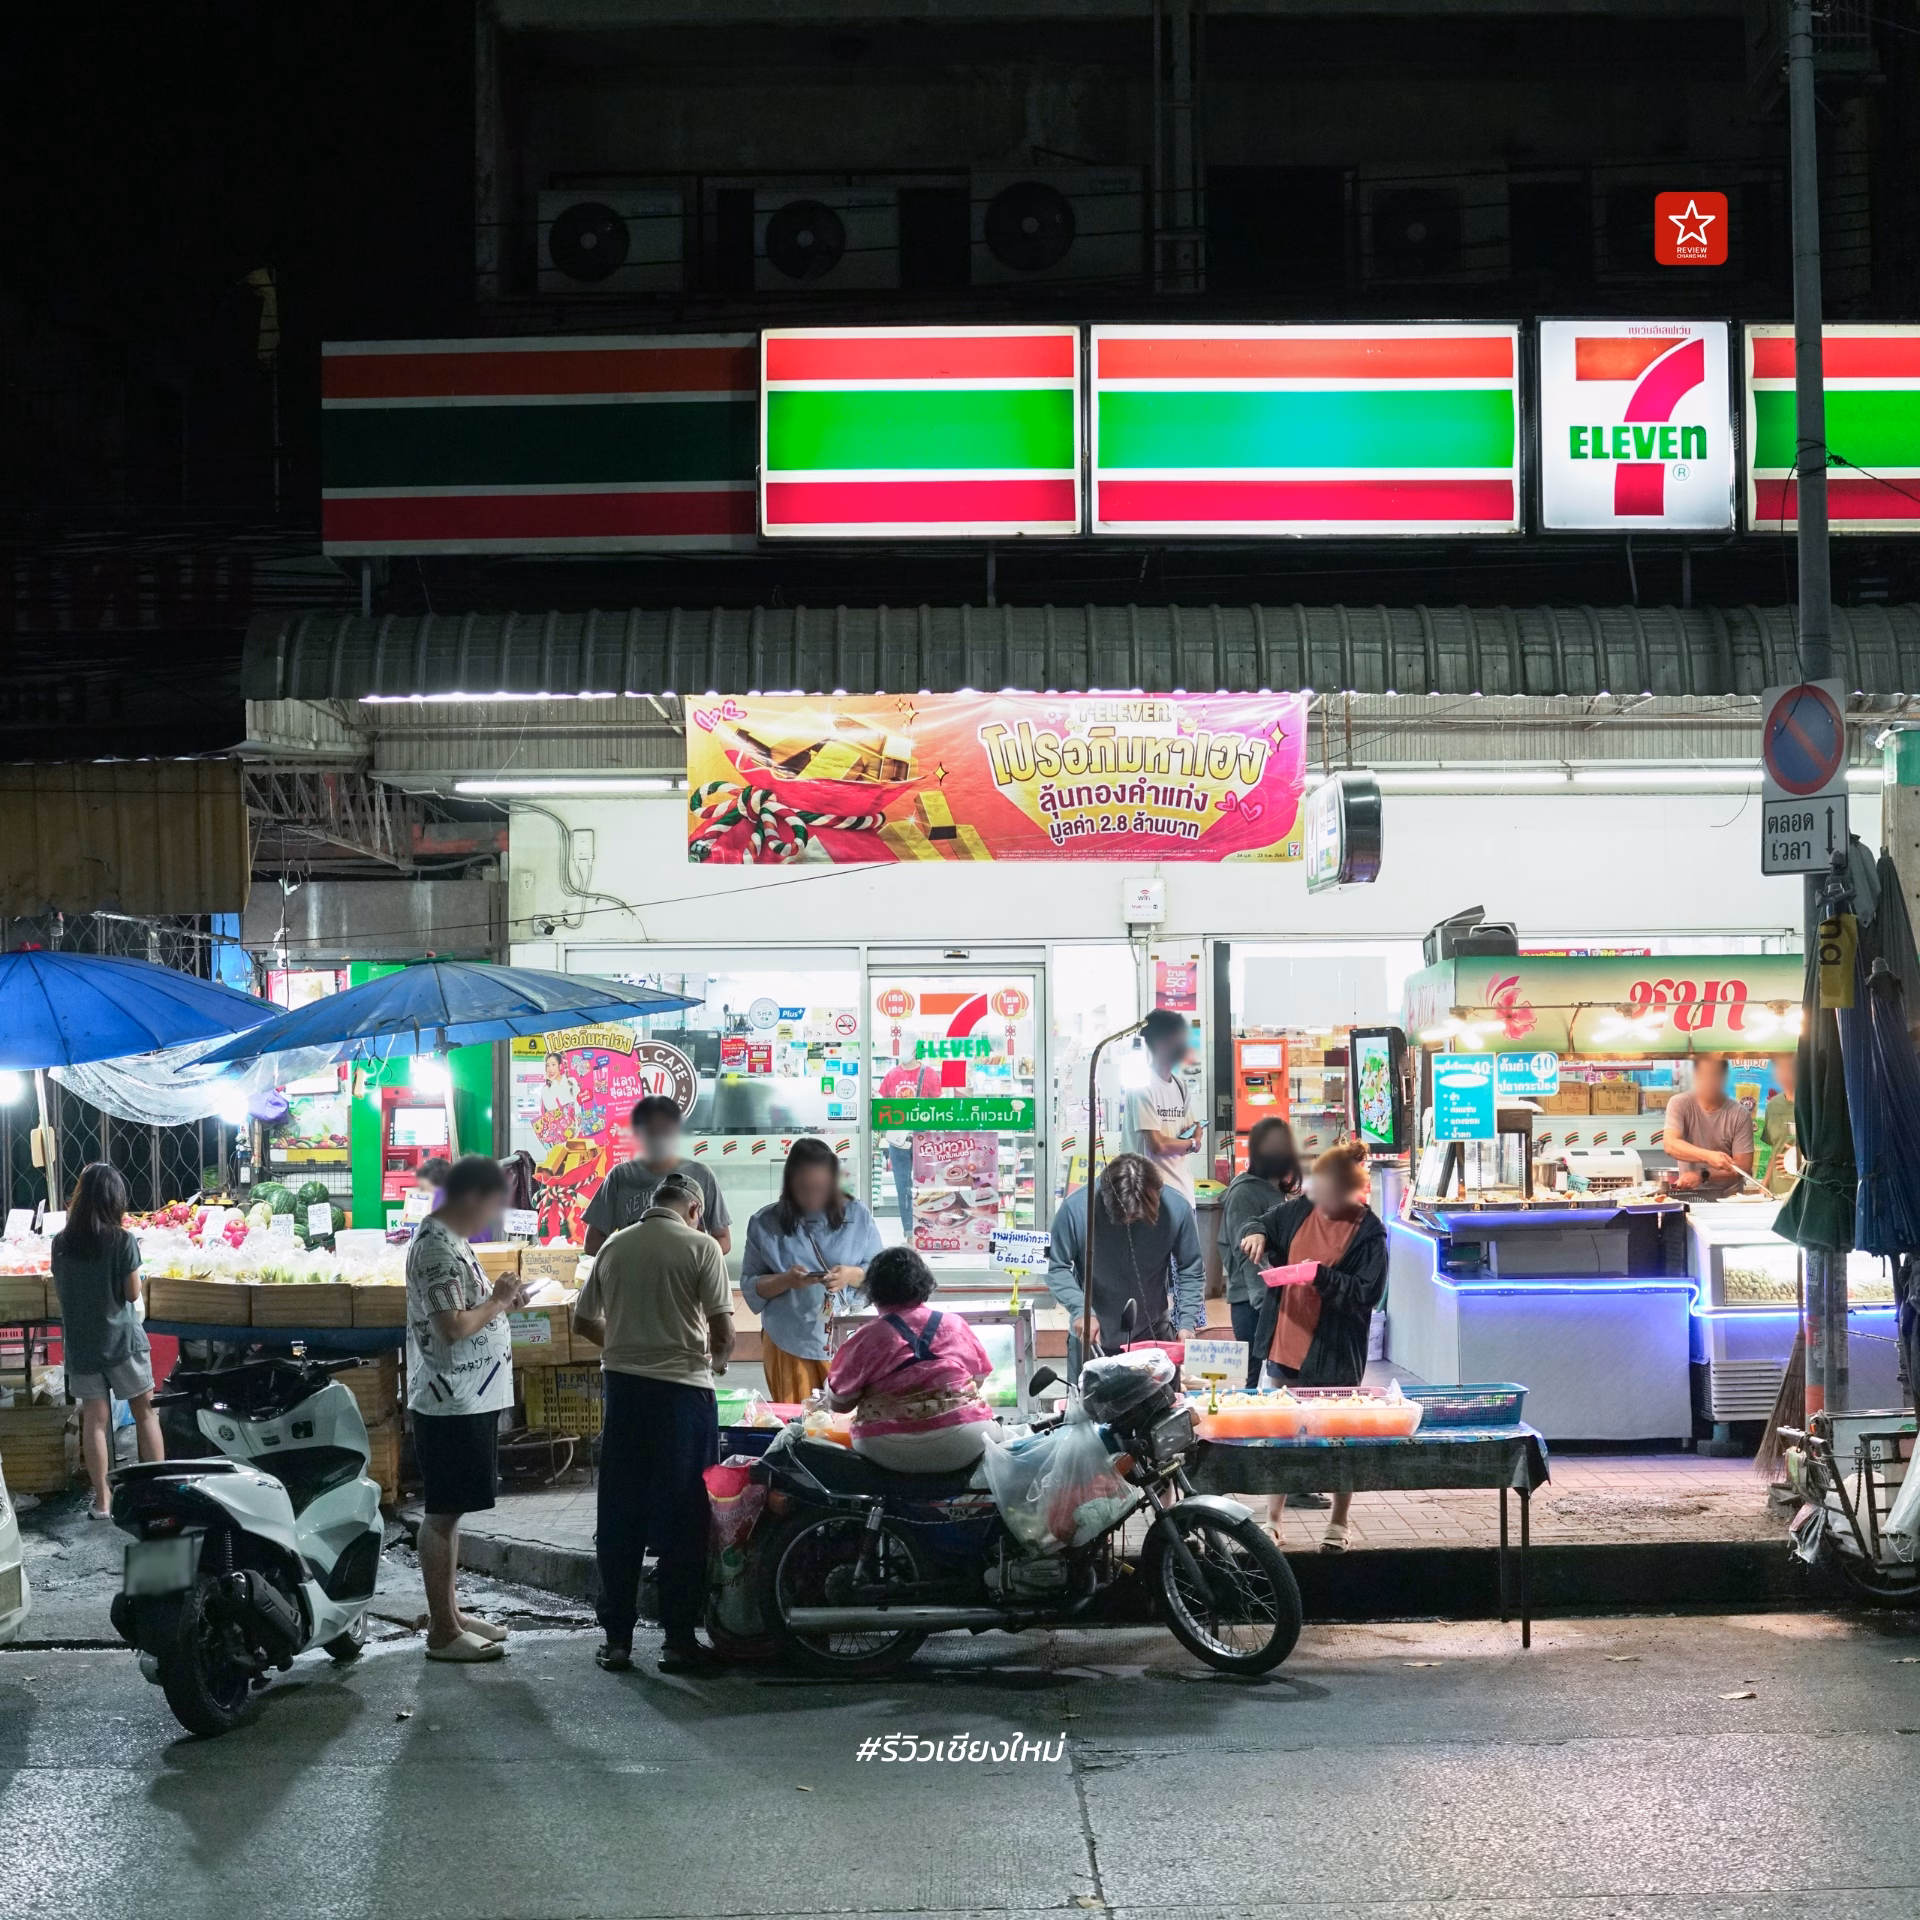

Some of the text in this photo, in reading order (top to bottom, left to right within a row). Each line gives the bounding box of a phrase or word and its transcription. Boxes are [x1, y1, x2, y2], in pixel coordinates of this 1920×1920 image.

[1629, 325, 1691, 335] เซเว่นอีเลฟเว่น
[1575, 338, 1705, 516] 7
[1039, 778, 1209, 819] ลุ้นทองคำแท่ง
[1050, 812, 1199, 844] มูลค่า 2.8 ล้านบาท
[1767, 811, 1814, 834] ตลอด
[1771, 839, 1811, 861] เวลา
[1167, 969, 1187, 977] true
[1165, 978, 1187, 988] 5G
[920, 993, 988, 1087] 7
[1500, 1055, 1554, 1072] ต้มยำ 40
[612, 1076, 636, 1087] แลก
[1497, 1078, 1557, 1092] ปลากระป๋อง
[609, 1086, 641, 1100] สุดเลิฟ
[920, 1139, 975, 1156] เติมหวาน
[997, 1251, 1004, 1261] 6
[1021, 1254, 1034, 1264] 10
[540, 1265, 552, 1274] 30
